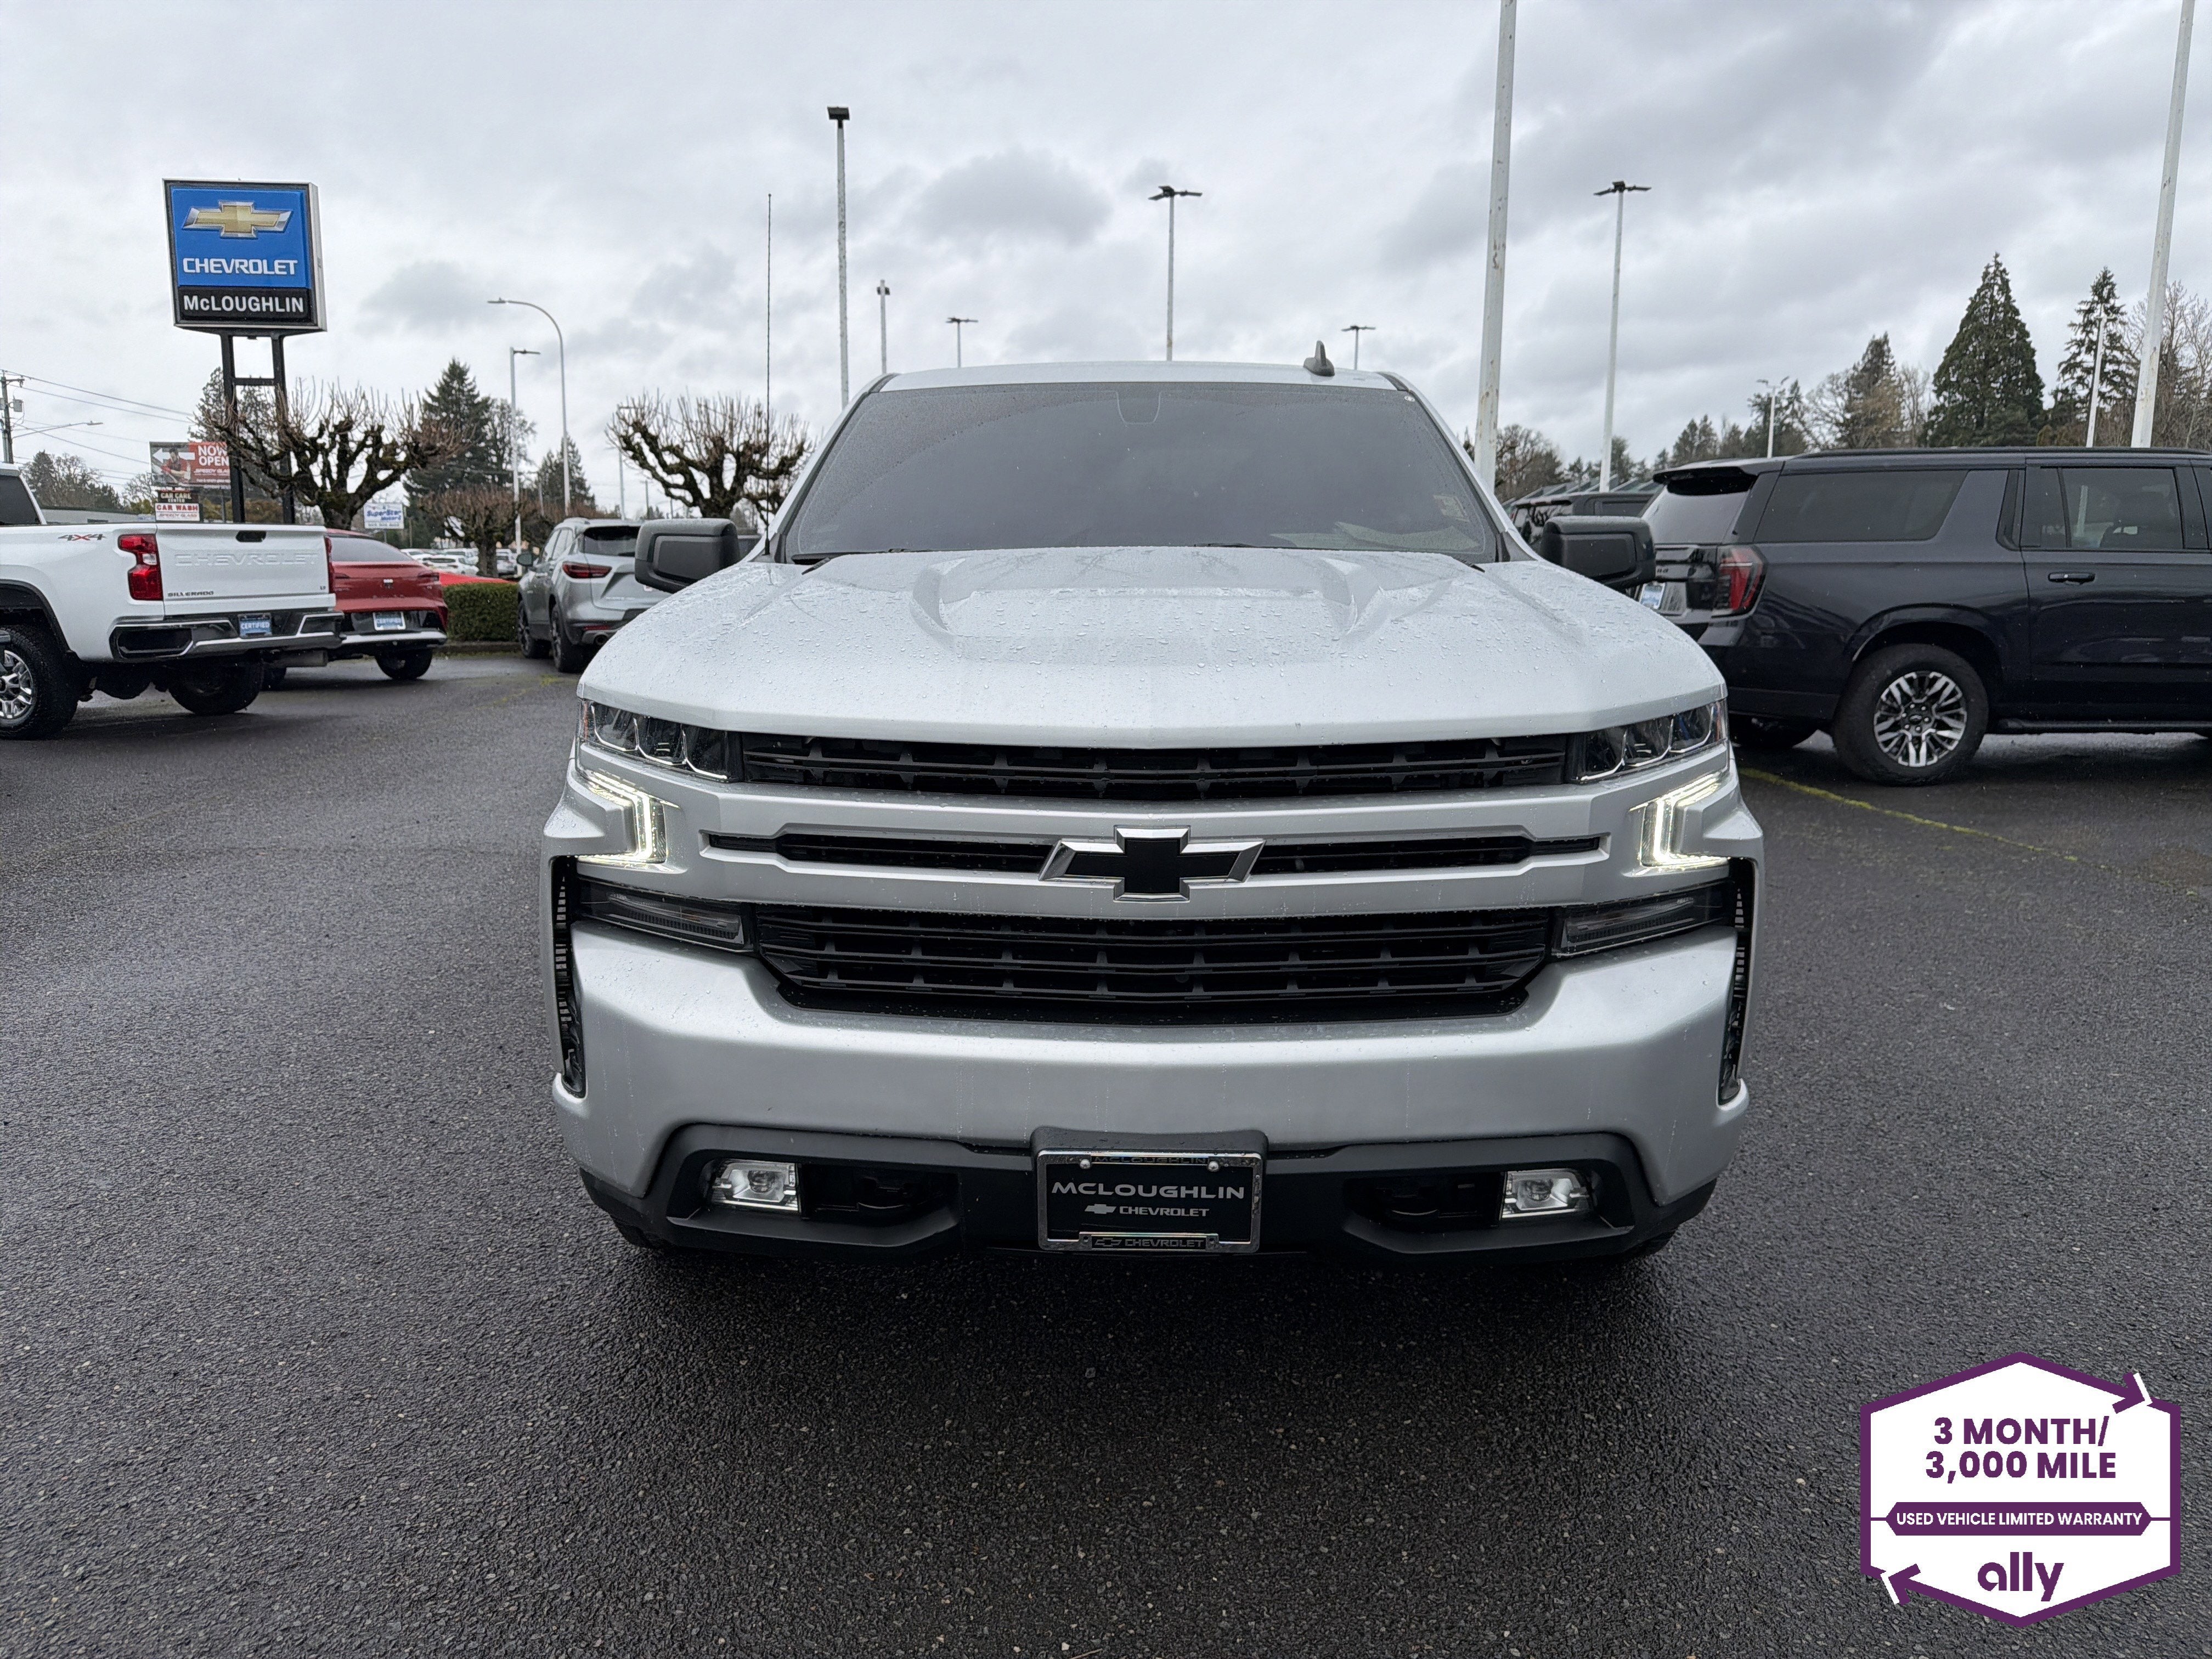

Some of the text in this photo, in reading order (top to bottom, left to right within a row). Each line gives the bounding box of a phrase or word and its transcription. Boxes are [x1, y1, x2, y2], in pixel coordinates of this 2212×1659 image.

[183, 258, 298, 275] CHEVROLET
[183, 295, 304, 313] McLOUGHLIN
[198, 445, 228, 456] NOW
[199, 456, 229, 466] OPEN
[174, 553, 318, 567] CHEVROLET
[1051, 1181, 1245, 1200] MCLOUGHLIN
[1119, 1206, 1210, 1217] CHEVROLET
[1125, 1238, 1204, 1248] CHEVROLET
